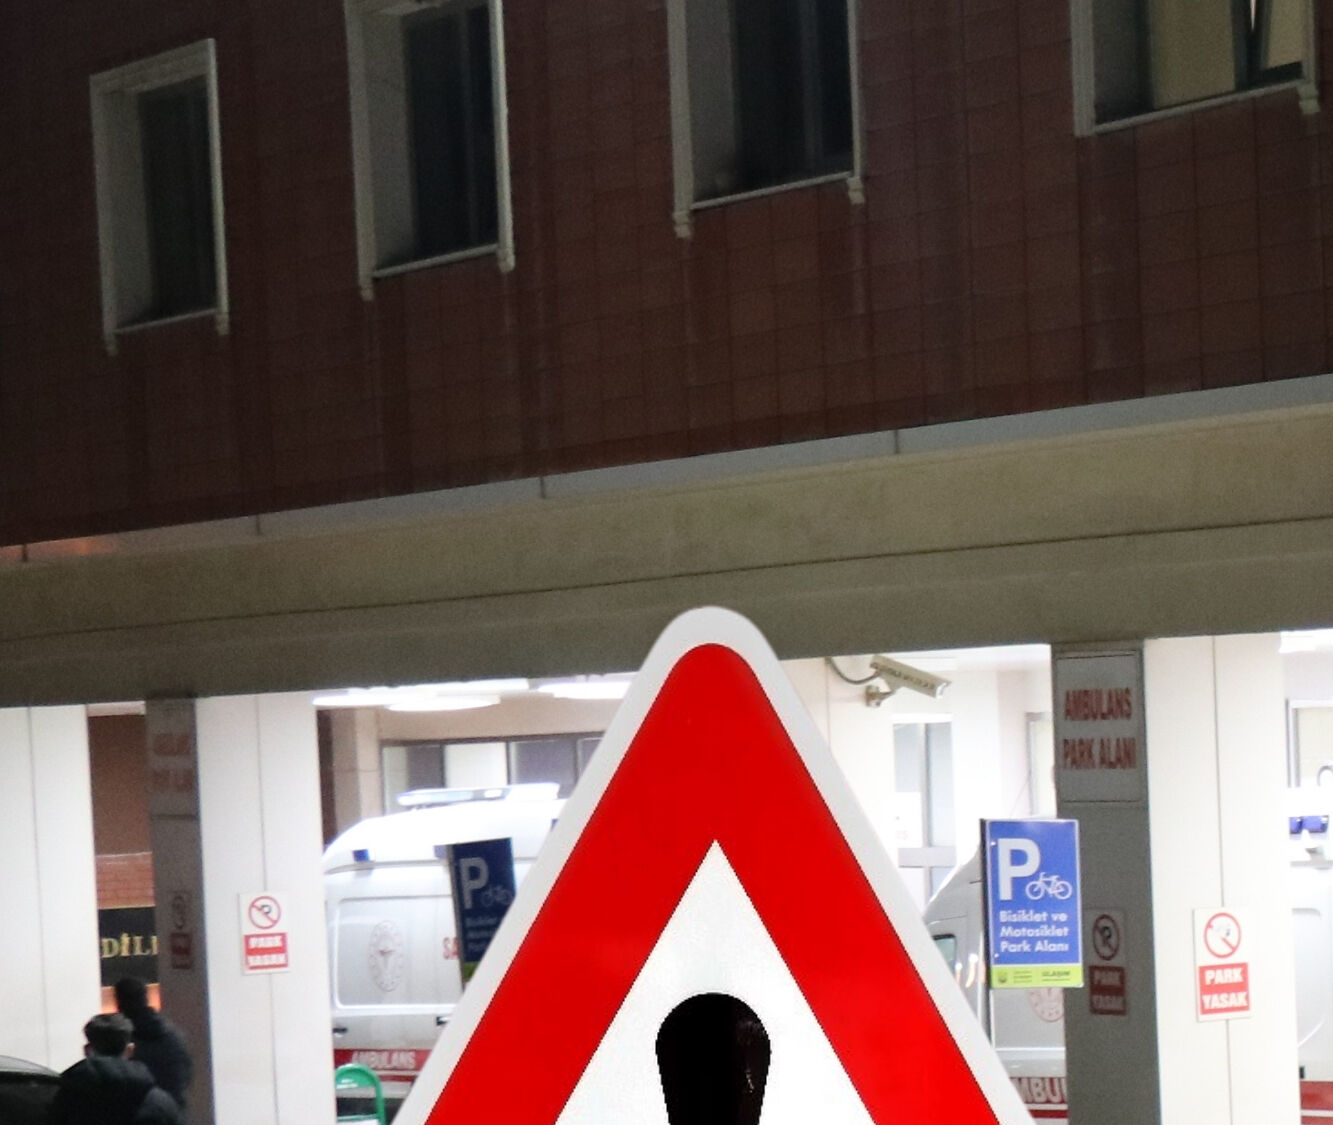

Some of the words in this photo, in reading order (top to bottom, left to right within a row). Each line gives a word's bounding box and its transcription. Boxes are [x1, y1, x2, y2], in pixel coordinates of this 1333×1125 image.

[1065, 688, 1132, 721] AMBULANS
[1063, 738, 1096, 770] PARK
[1100, 737, 1137, 769] ALANI
[998, 838, 1041, 900] P
[459, 857, 489, 910] P
[999, 911, 1047, 923] Bisiklet
[1051, 913, 1068, 923] ve
[1000, 926, 1069, 938] Motosiklet
[1001, 941, 1031, 953] Park
[1204, 968, 1243, 985] PARK
[1202, 992, 1248, 1010] YASAK
